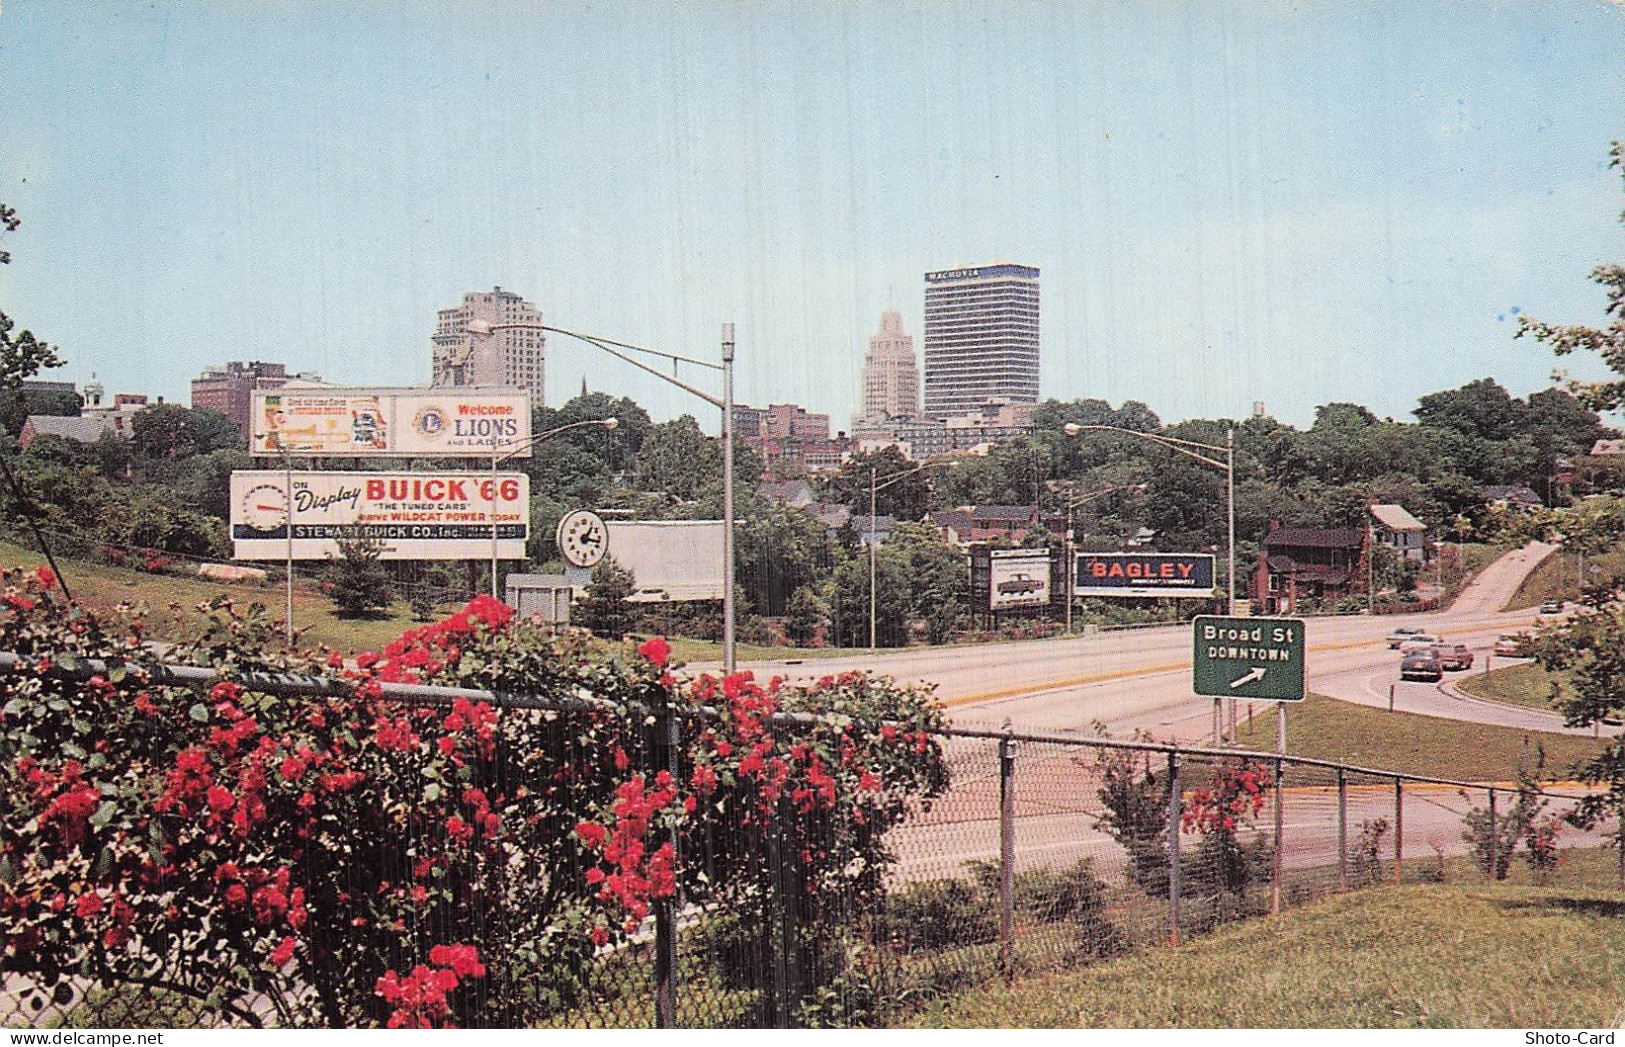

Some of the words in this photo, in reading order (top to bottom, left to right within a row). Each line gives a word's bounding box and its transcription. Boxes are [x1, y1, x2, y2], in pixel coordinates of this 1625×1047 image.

[458, 404, 513, 416] Welcome
[454, 419, 517, 437] LIONS
[293, 481, 308, 489] ON
[366, 479, 469, 501] BUICK
[294, 485, 361, 512] Display
[402, 502, 434, 510] TUNED
[391, 512, 443, 521] WILDCAT
[446, 512, 486, 521] POWER
[364, 526, 407, 538] BUICK
[1092, 562, 1194, 578] BAGLEY
[1204, 625, 1261, 641] Broad
[1273, 627, 1294, 643] St
[1208, 646, 1289, 661] DOWNTOWN
